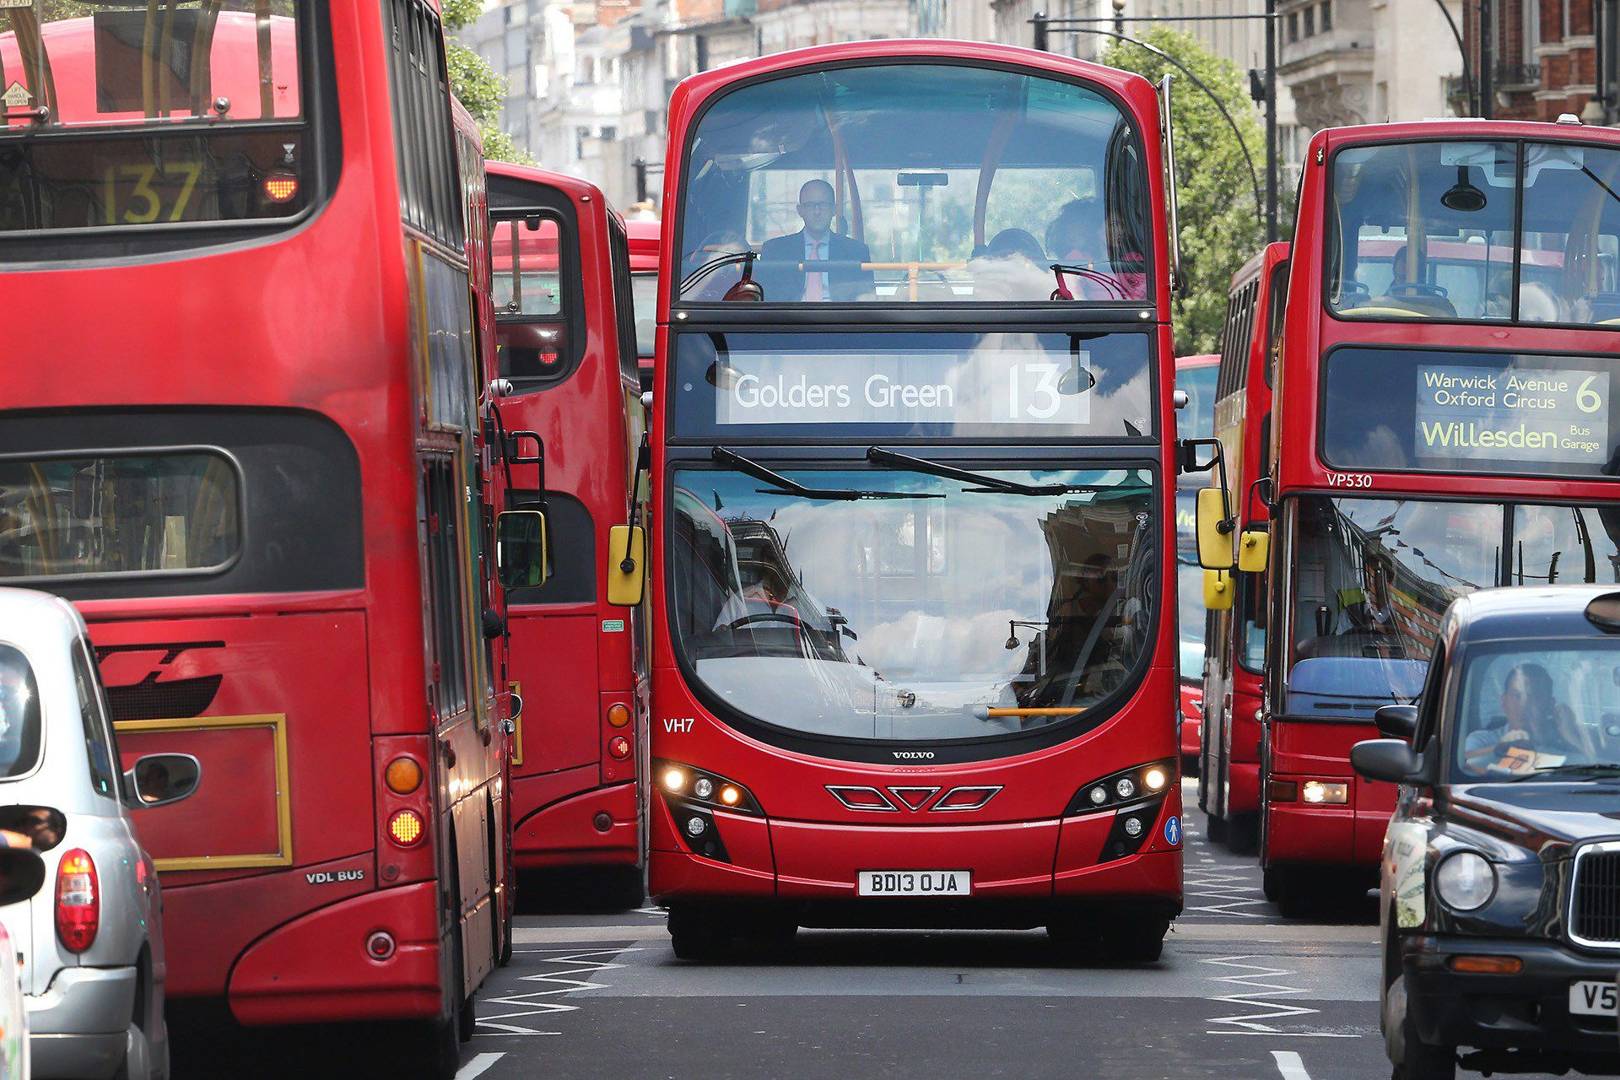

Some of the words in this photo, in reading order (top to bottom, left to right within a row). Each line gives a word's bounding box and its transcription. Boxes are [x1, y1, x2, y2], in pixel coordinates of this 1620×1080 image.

[104, 162, 203, 225] 137
[734, 373, 850, 408] Golders
[864, 373, 953, 408] Green
[1009, 362, 1061, 419] 13
[1424, 372, 1497, 390] Warwick
[1506, 375, 1568, 392] Avenue
[1434, 390, 1495, 407] Oxford
[1503, 393, 1556, 409] Circus
[1576, 375, 1602, 413] 6
[1421, 421, 1558, 449] Willesden
[1569, 425, 1591, 436] Bus
[1560, 438, 1600, 453] Garage
[1326, 473, 1373, 488] VP530
[663, 718, 695, 733] VH7
[892, 751, 935, 759] VOLVO
[306, 872, 334, 884] VDL
[337, 870, 364, 881] BUS
[872, 873, 915, 892] BD13
[920, 873, 958, 892] OJA
[1583, 984, 1617, 1010] V5
